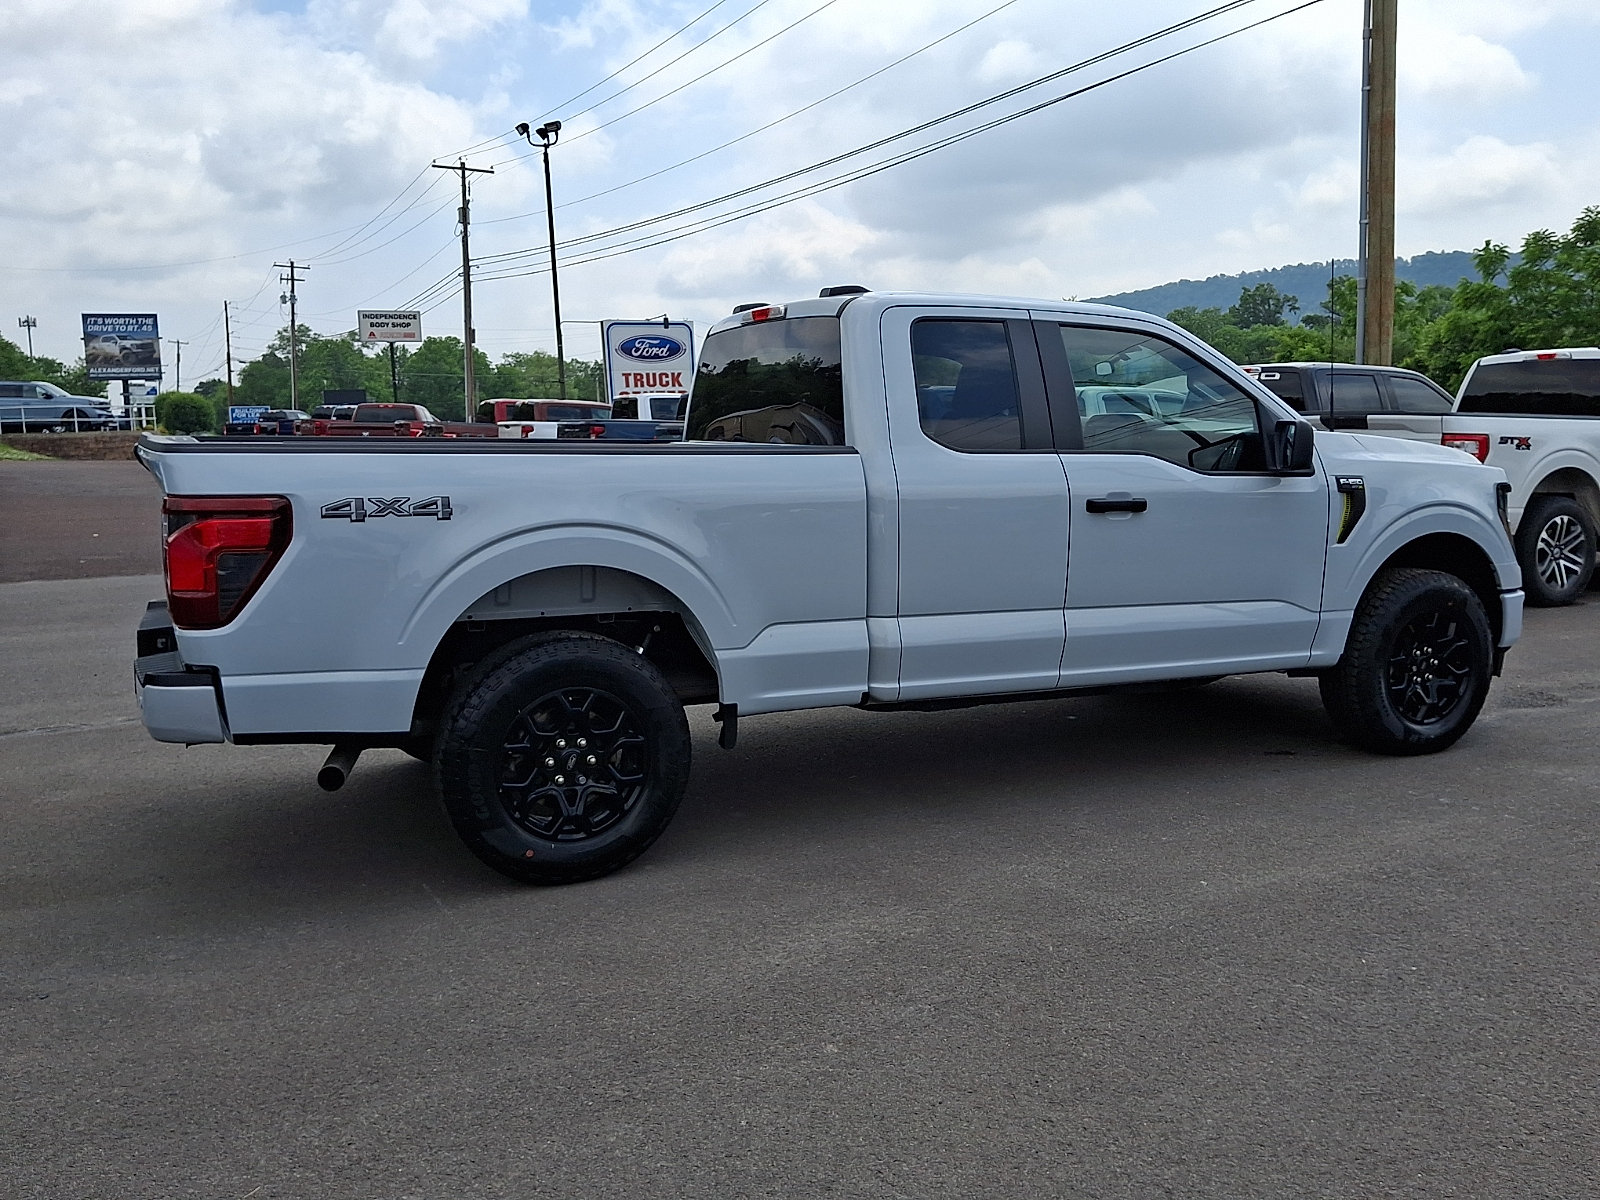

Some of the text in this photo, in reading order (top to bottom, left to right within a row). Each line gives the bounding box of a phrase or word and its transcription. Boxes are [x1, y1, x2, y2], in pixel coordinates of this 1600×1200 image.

[86, 317, 154, 325] IT'S WORTH THE
[87, 324, 113, 332] DRIVE
[115, 324, 126, 332] TO
[631, 338, 671, 357] Ford
[621, 372, 684, 389] TRUCK
[1498, 436, 1532, 446] STX
